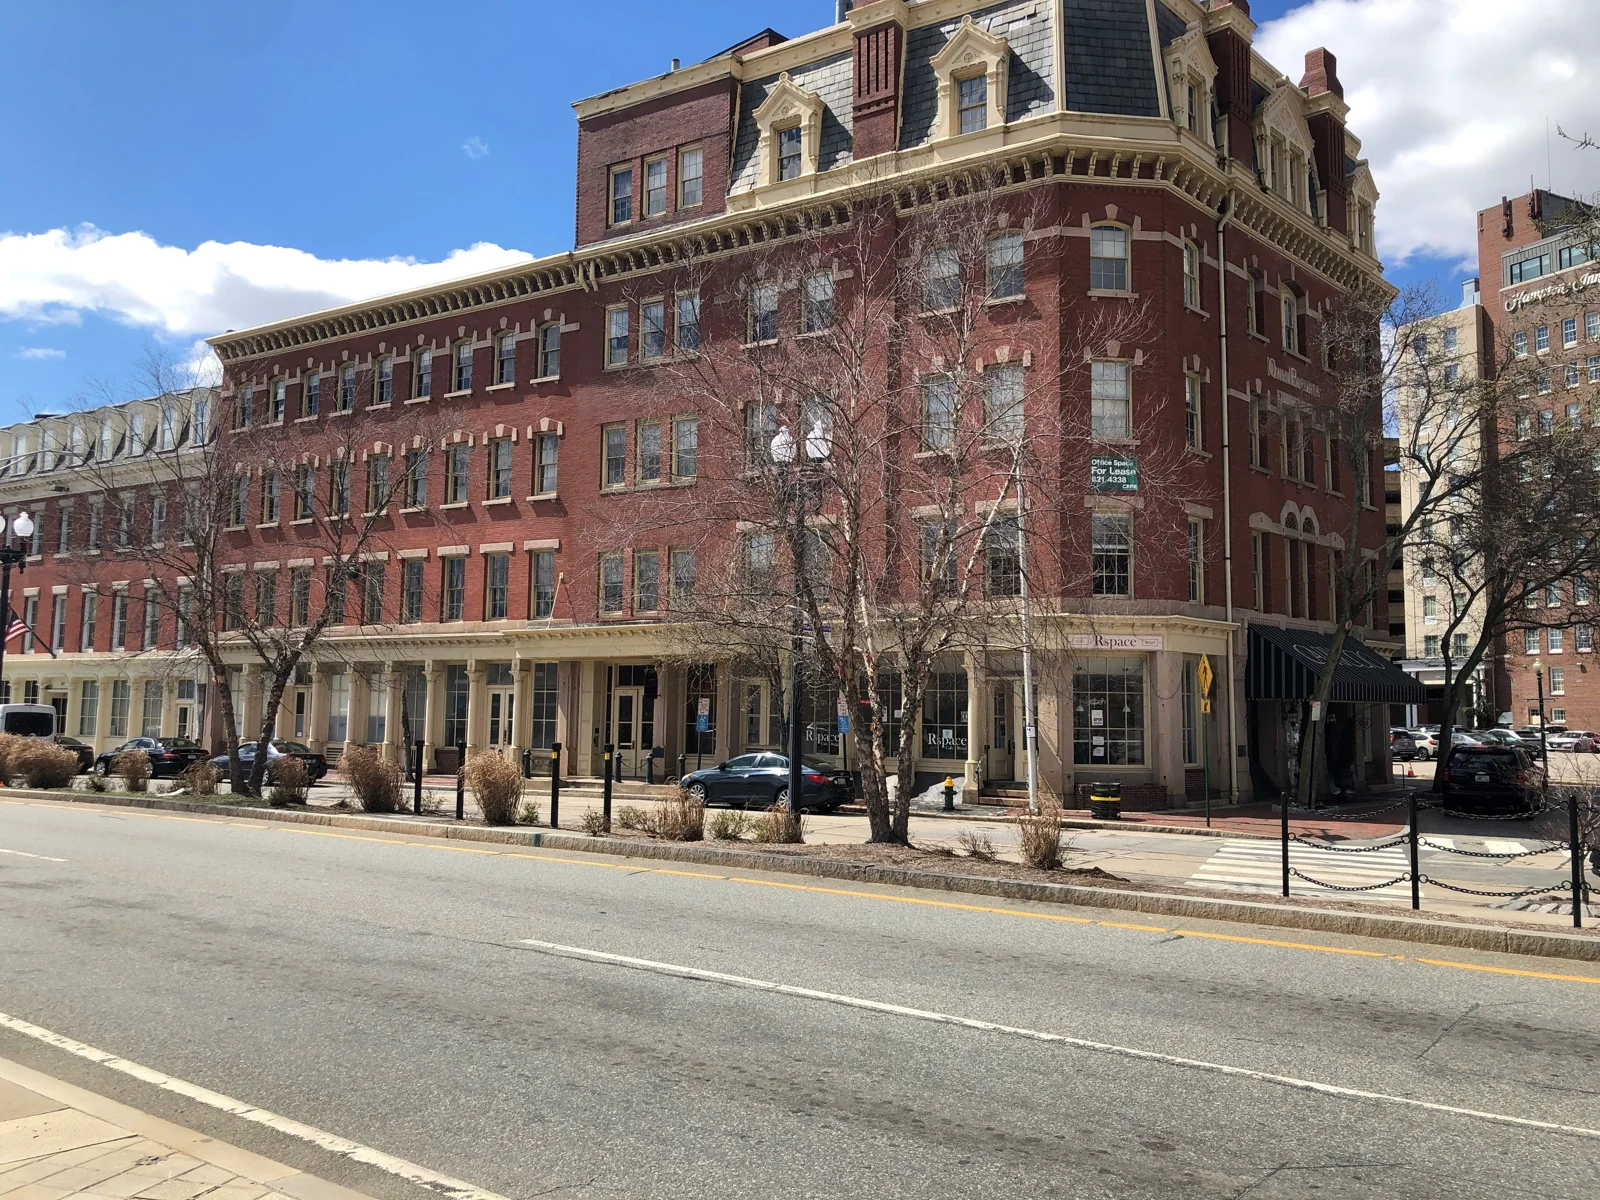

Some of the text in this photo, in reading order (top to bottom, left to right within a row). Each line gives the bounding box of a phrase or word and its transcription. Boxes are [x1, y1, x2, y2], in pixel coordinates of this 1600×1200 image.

[1505, 283, 1569, 312] Hampton
[1091, 466, 1136, 475] For Lease
[1095, 635, 1137, 649] Rspace
[805, 730, 840, 744] Rpace
[927, 732, 968, 748] Rspace
